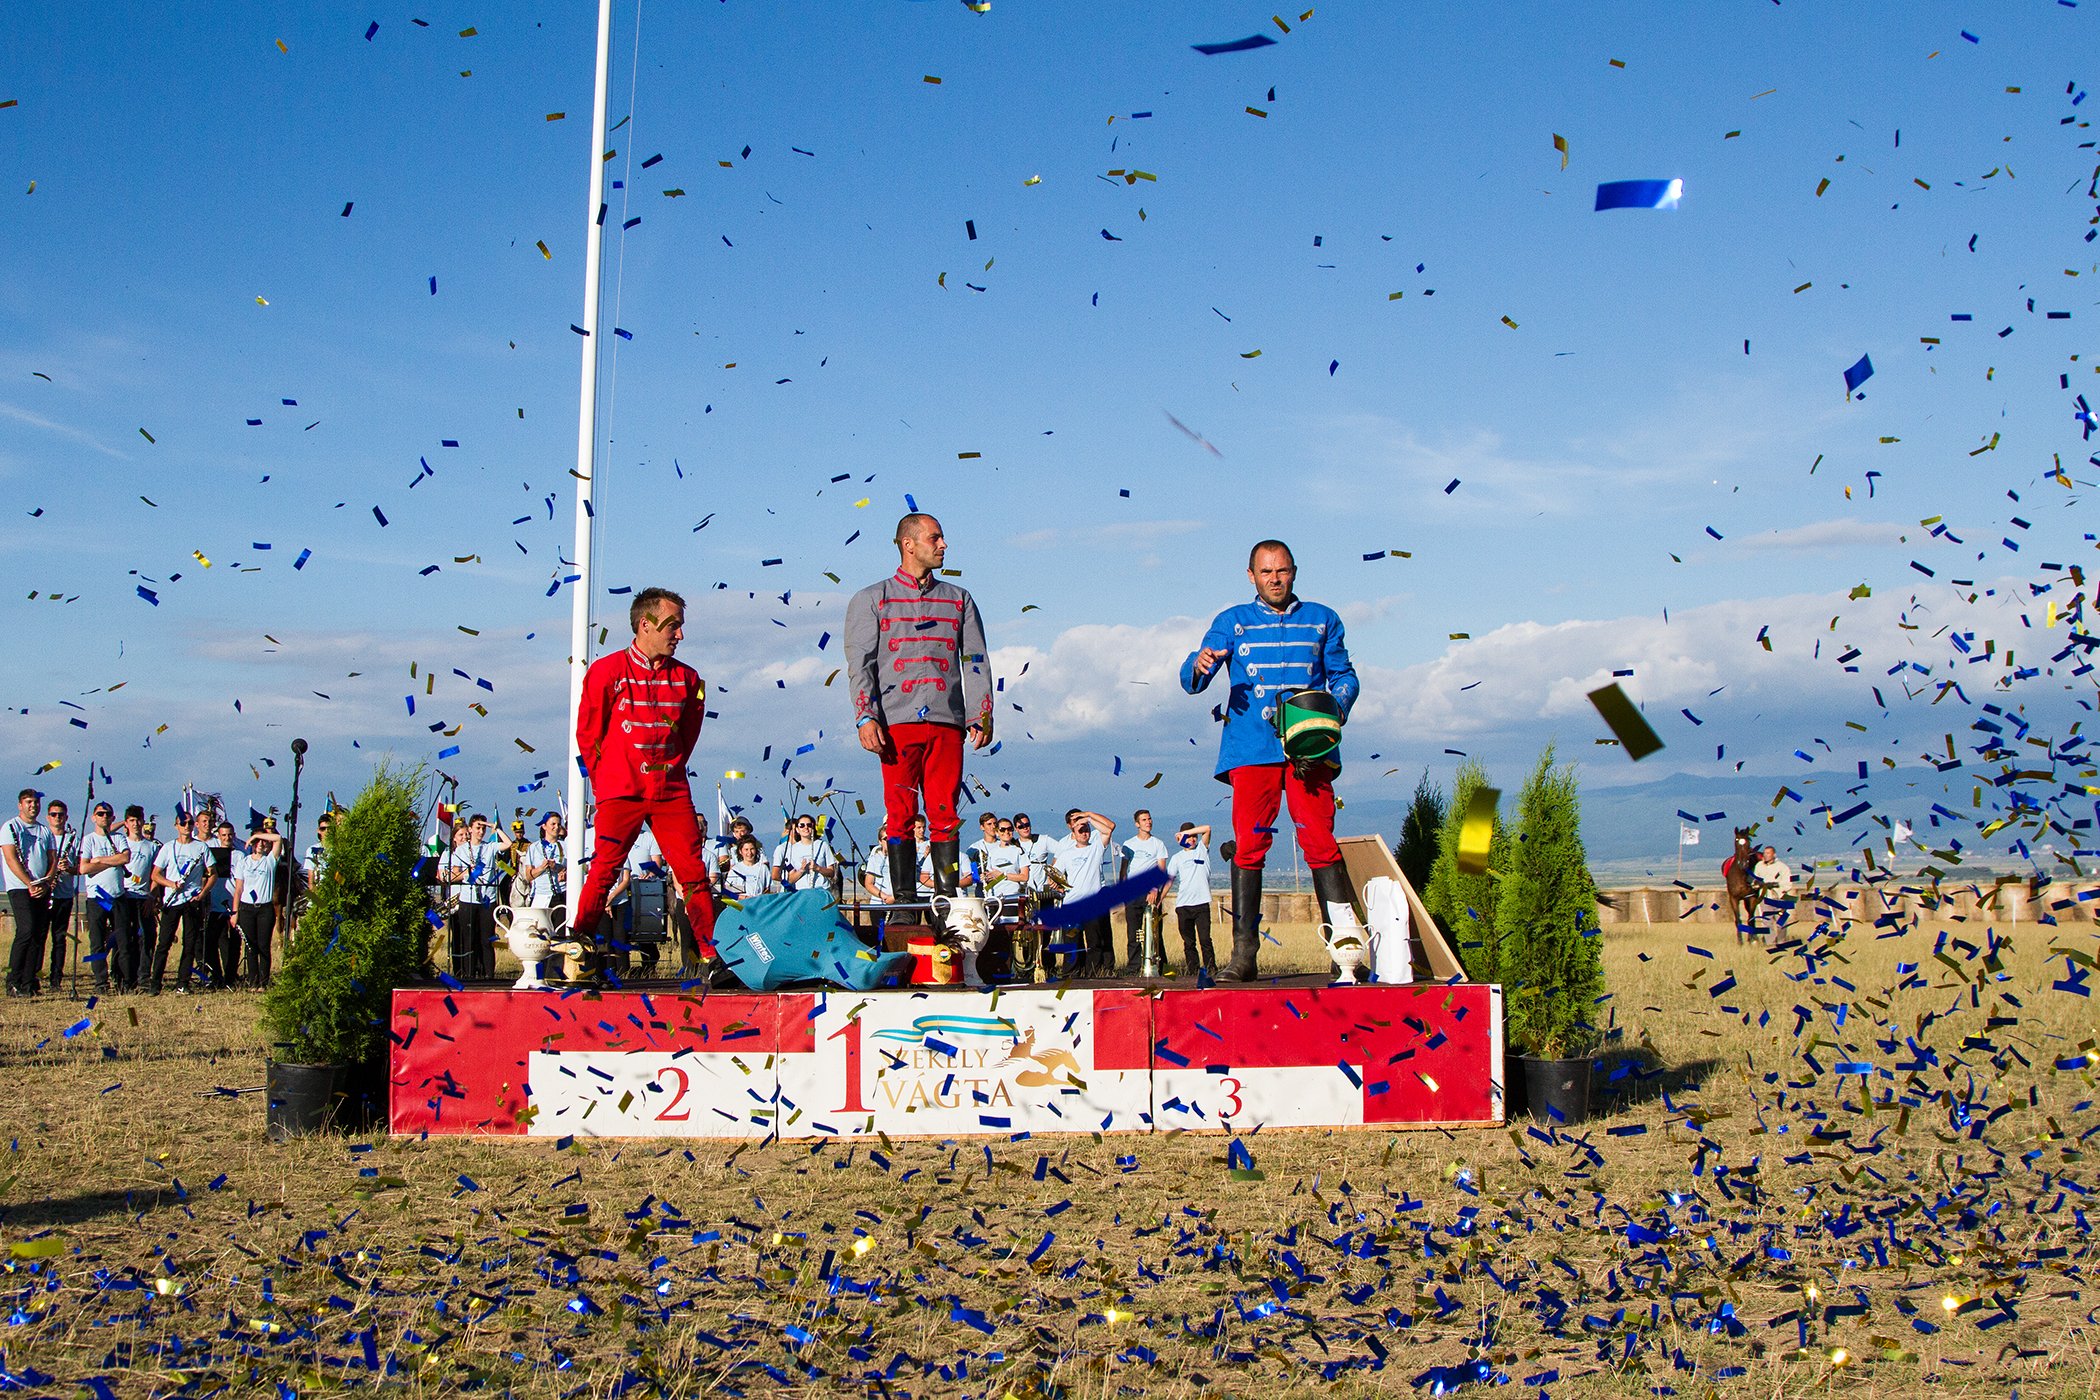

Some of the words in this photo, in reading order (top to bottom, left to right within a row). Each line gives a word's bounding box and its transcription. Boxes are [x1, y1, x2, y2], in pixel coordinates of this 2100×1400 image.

[750, 934, 771, 961] Wintec
[827, 1017, 875, 1112] 1
[654, 1067, 691, 1121] 2
[881, 1072, 1015, 1110] VÁGTA
[1219, 1078, 1242, 1118] 3
